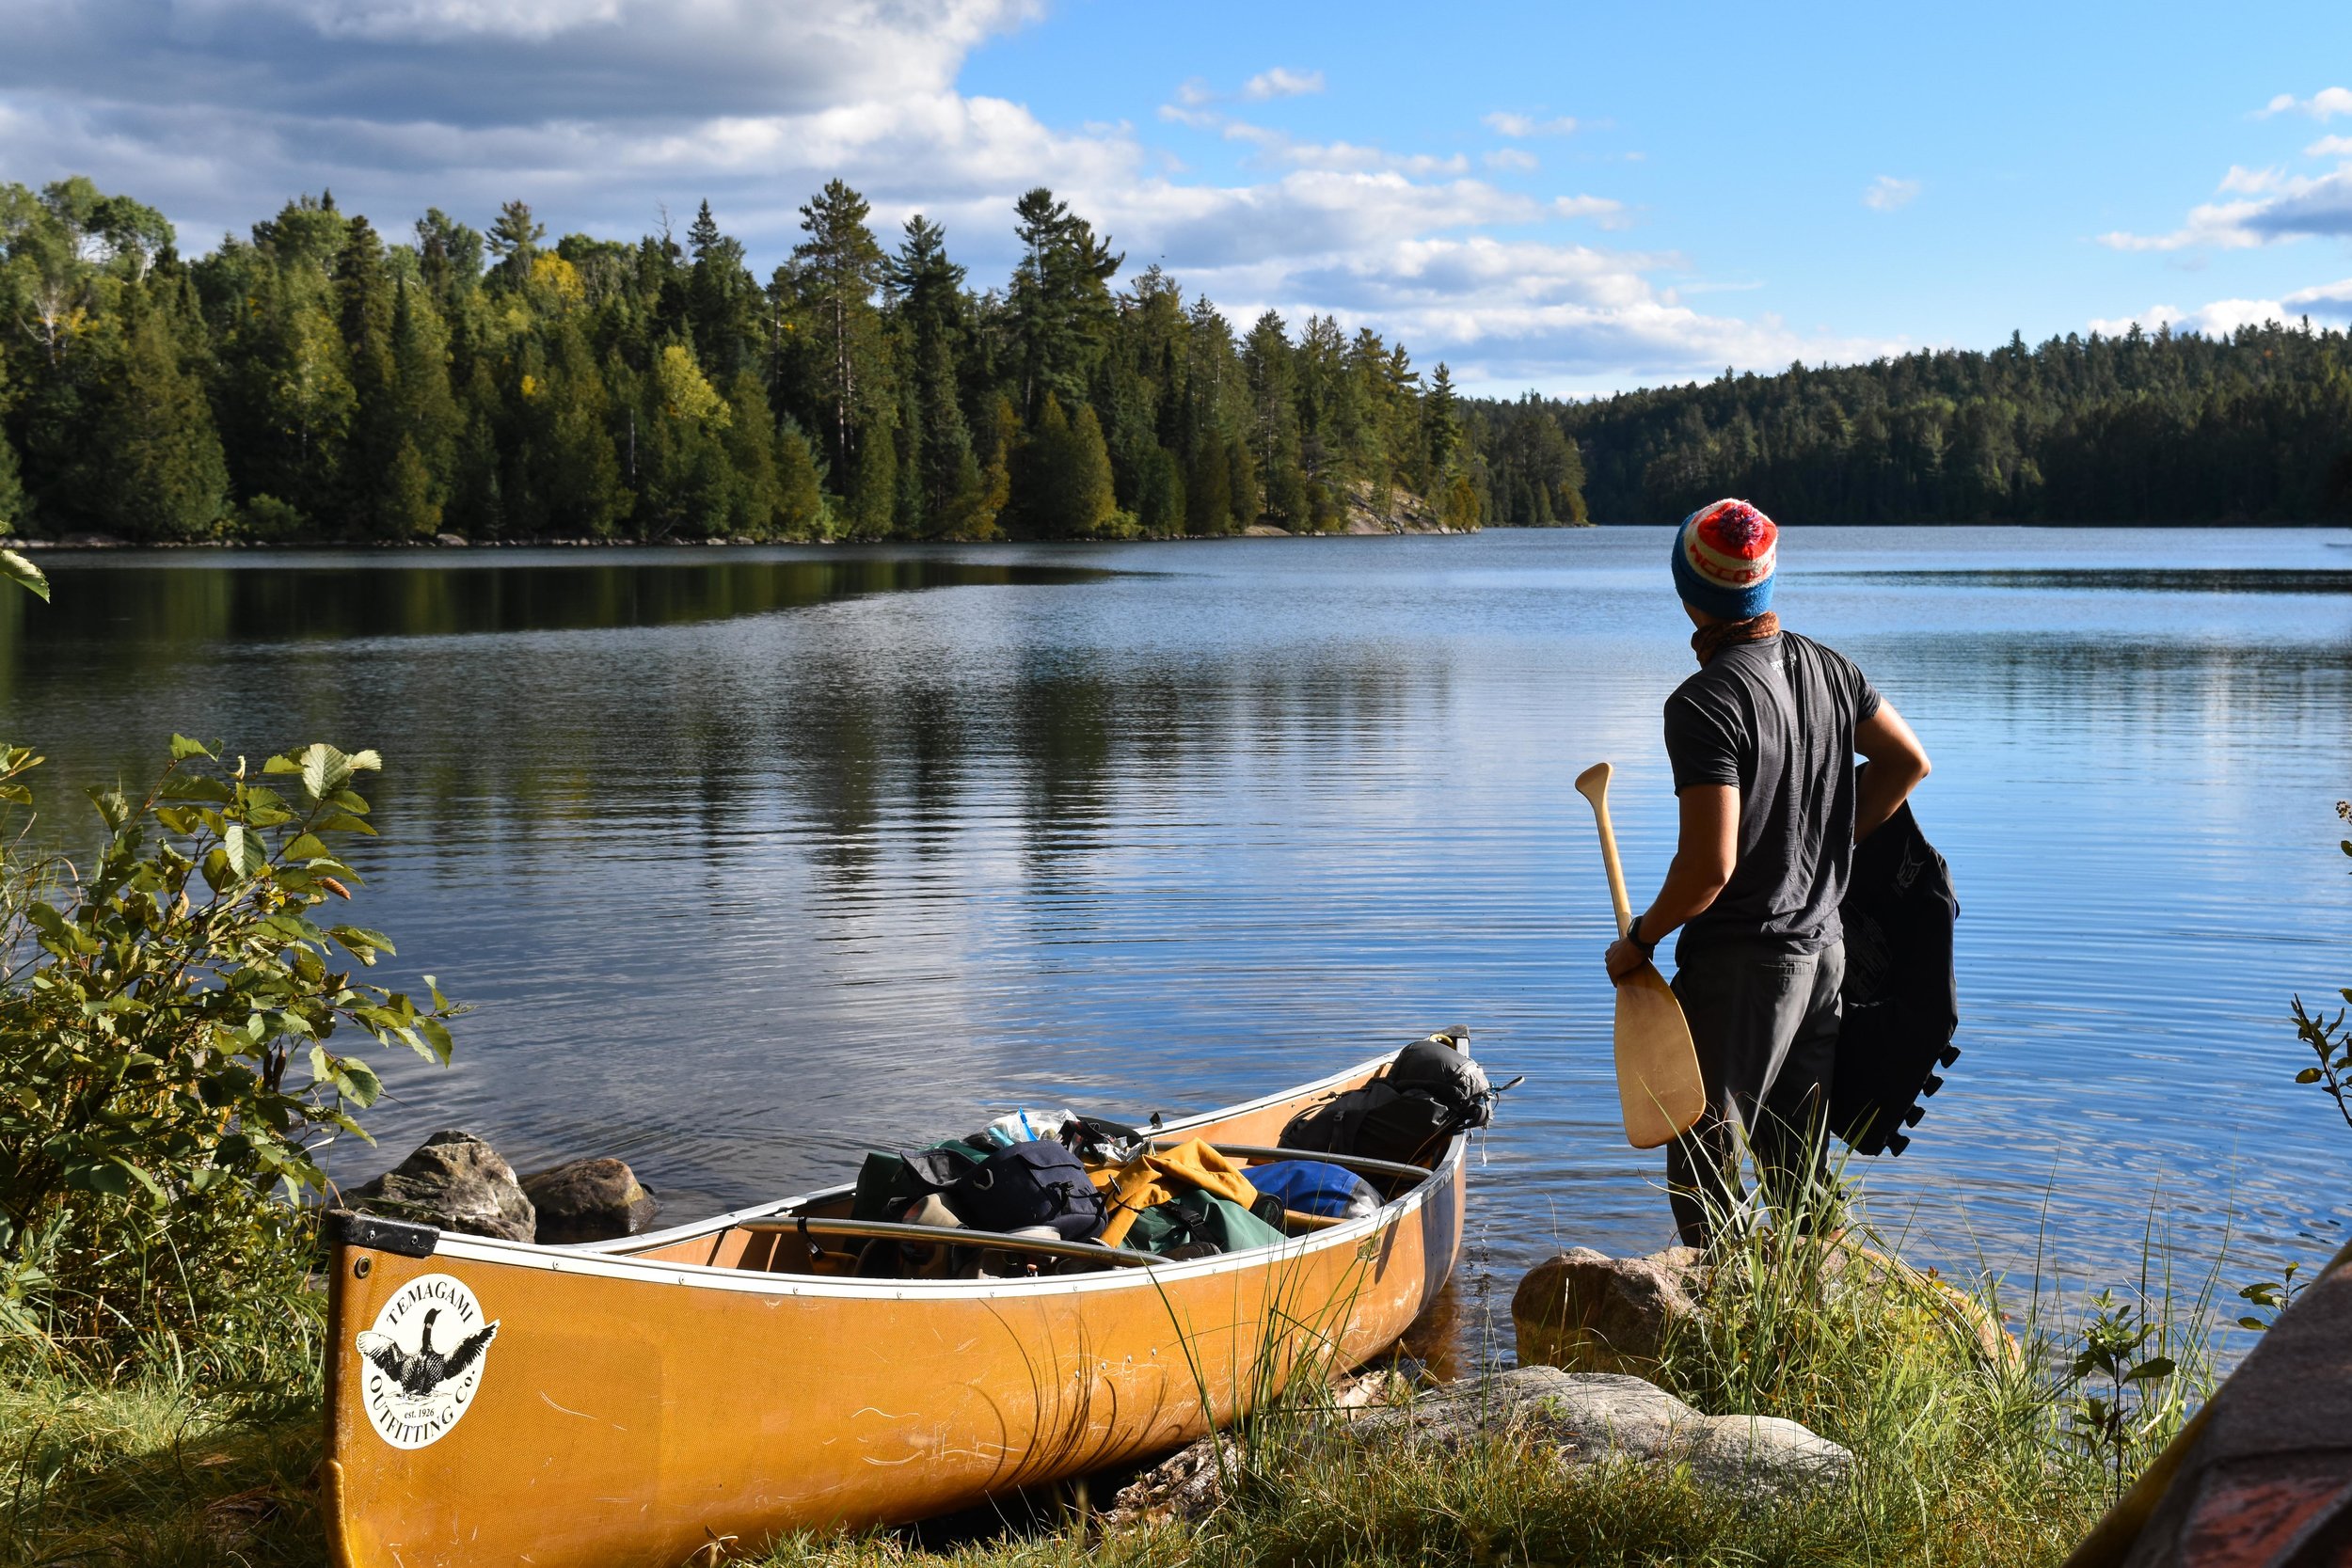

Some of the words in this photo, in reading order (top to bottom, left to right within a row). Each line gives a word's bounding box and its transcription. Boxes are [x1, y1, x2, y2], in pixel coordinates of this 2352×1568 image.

[386, 1281, 474, 1325] TEMAGAMI
[370, 1374, 453, 1443] OUTFITTING
[404, 1409, 417, 1419] est.
[418, 1408, 435, 1418] 1926
